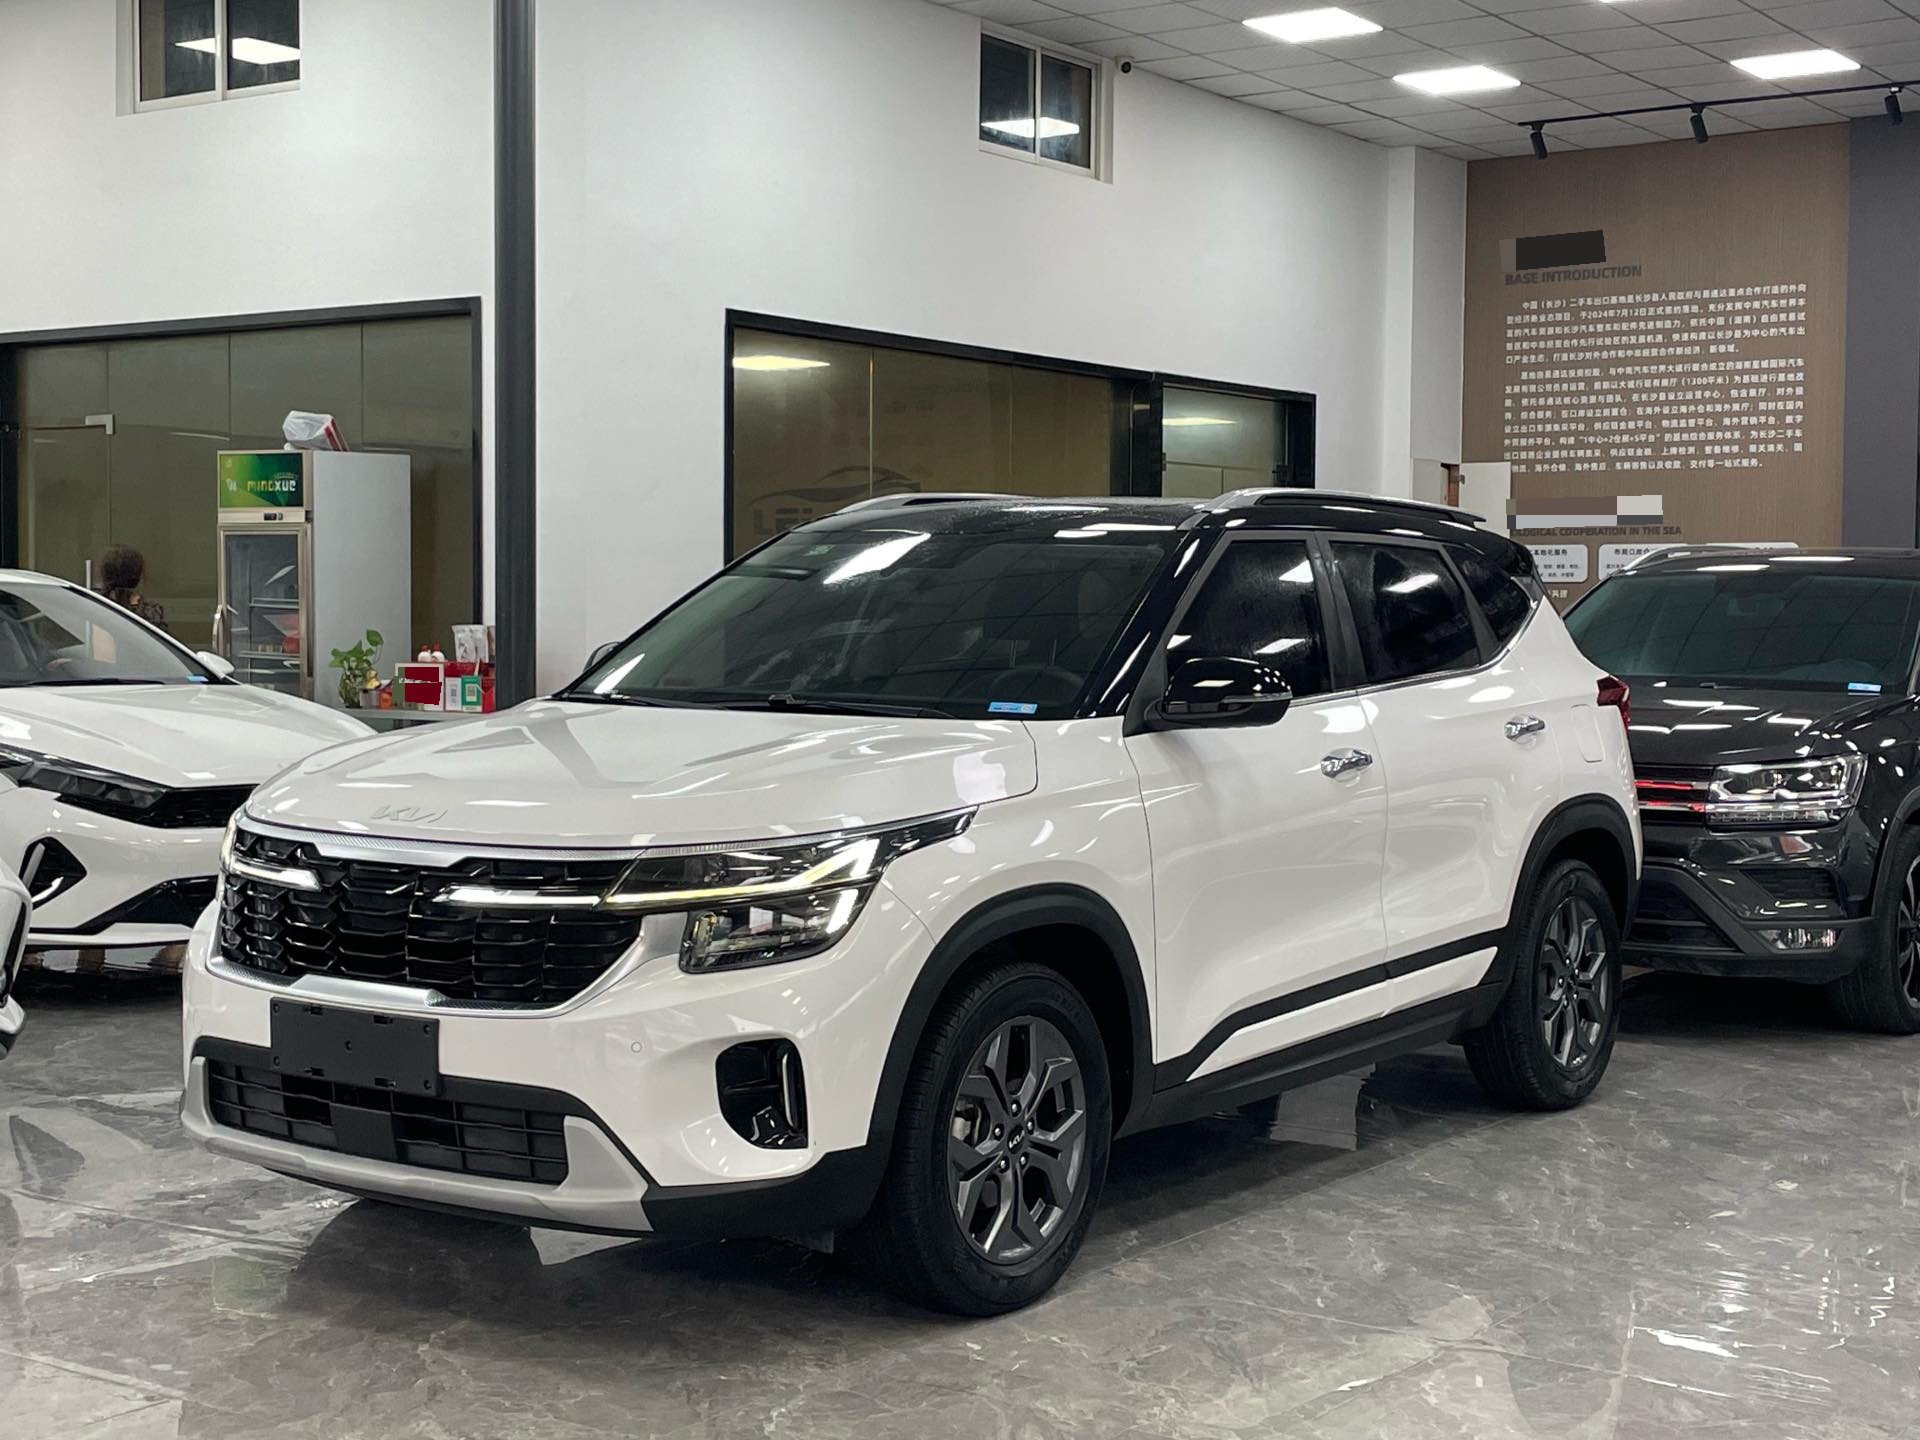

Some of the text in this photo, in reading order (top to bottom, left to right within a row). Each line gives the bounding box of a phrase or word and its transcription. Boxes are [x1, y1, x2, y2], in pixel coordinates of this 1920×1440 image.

[1504, 264, 1643, 286] BASE INTRODUCTION
[1559, 525, 1627, 537] COOPERATION
[1629, 525, 1640, 536] IN
[1643, 525, 1660, 536] THE
[1662, 525, 1682, 536] SEA
